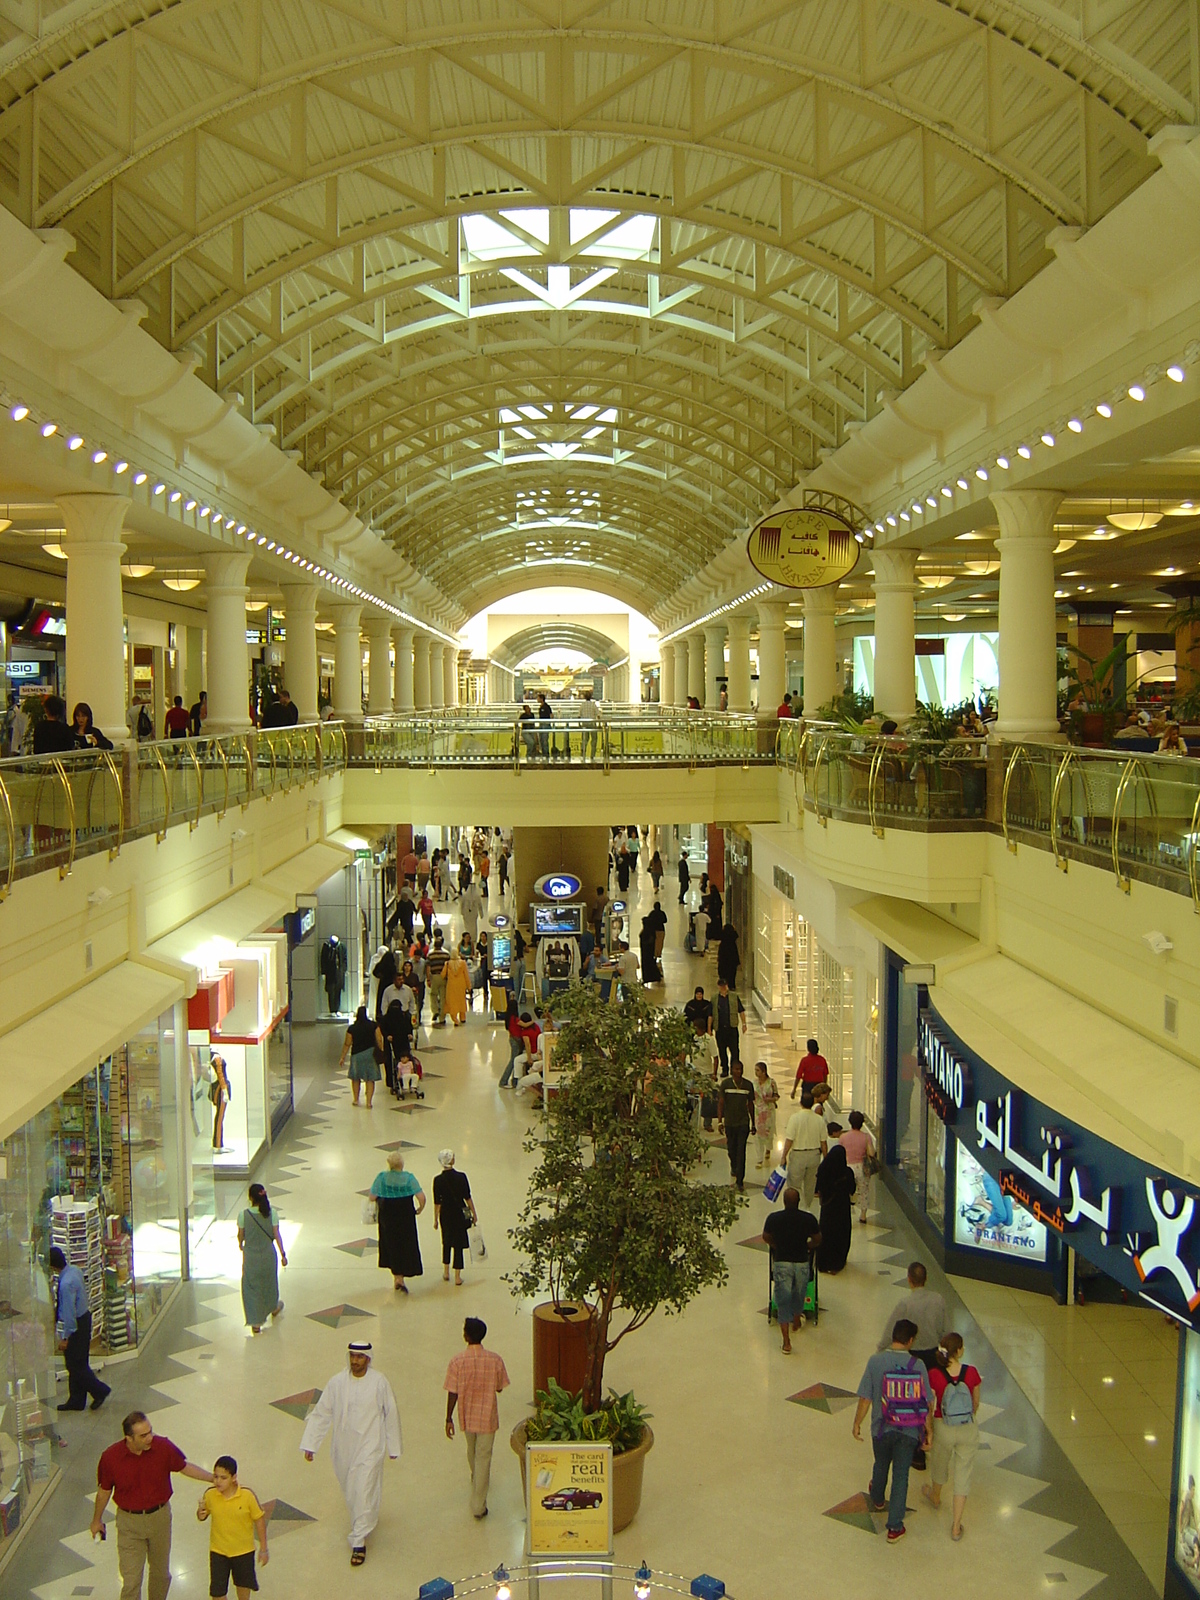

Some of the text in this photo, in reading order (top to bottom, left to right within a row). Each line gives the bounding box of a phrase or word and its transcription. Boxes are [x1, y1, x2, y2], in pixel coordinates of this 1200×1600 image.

[785, 515, 824, 531] CAFE
[976, 1228, 1036, 1248] BRANTANO
[572, 1461, 604, 1475] real
[571, 1476, 605, 1484] benefits
